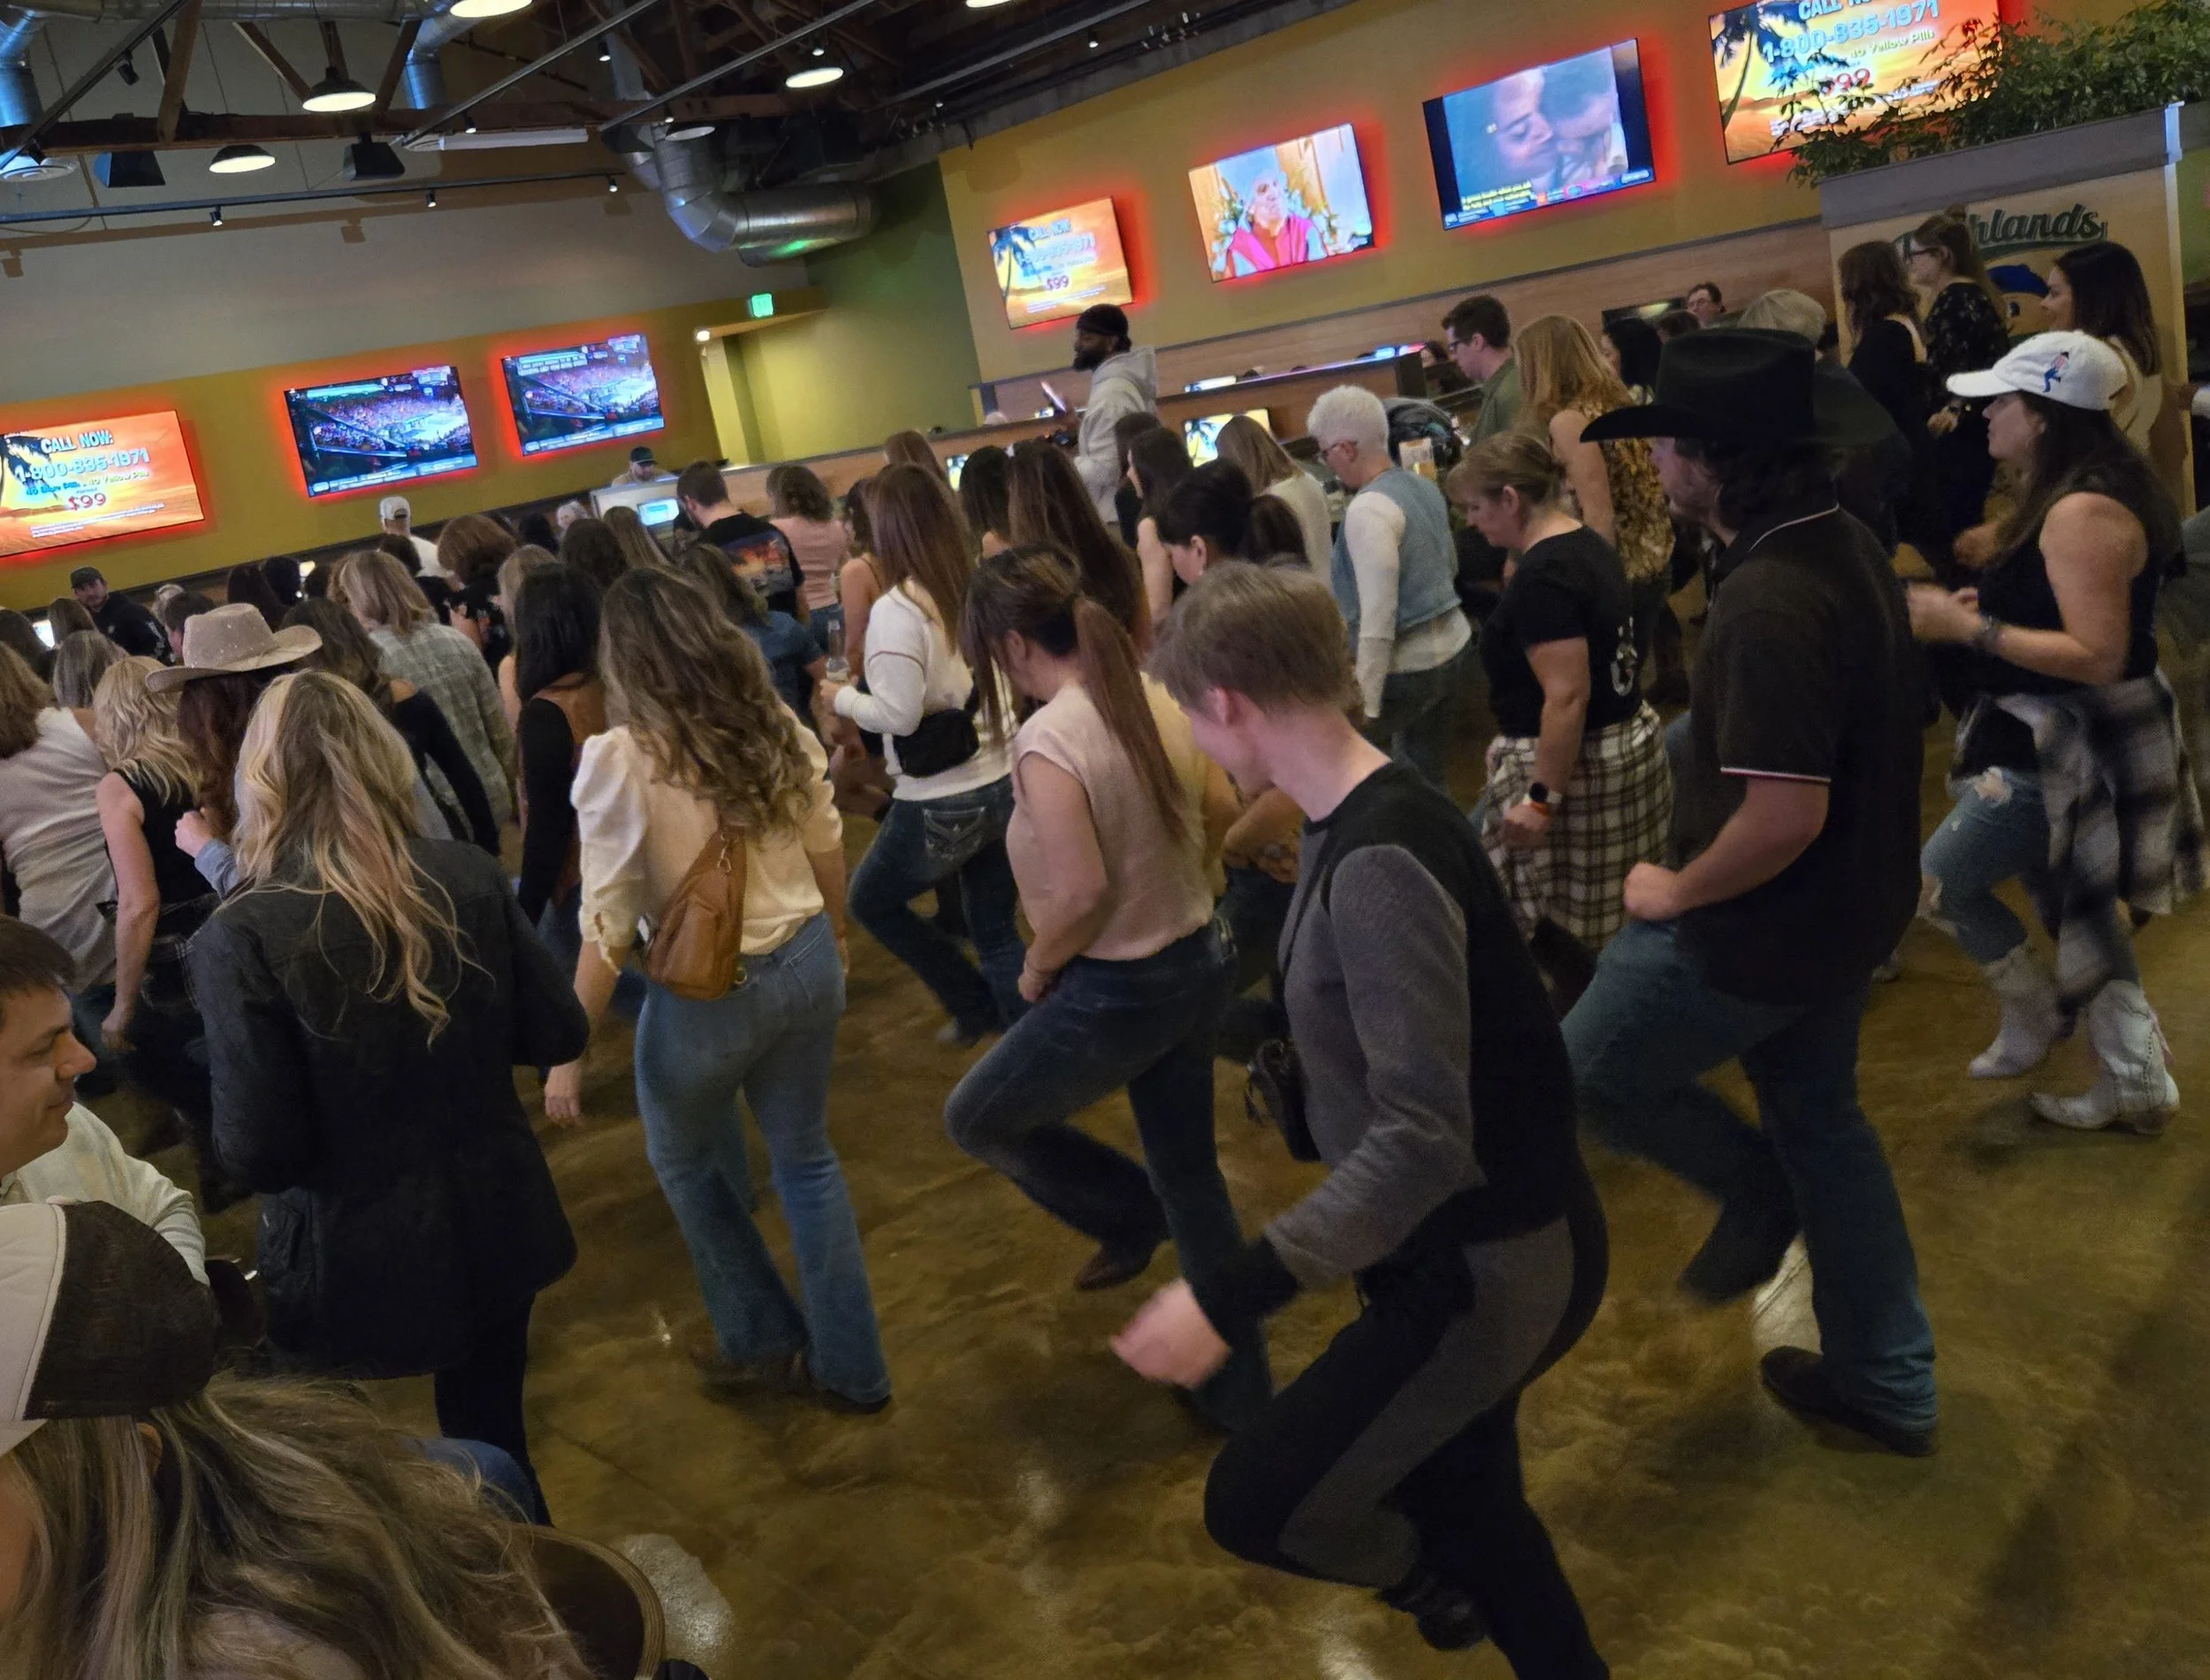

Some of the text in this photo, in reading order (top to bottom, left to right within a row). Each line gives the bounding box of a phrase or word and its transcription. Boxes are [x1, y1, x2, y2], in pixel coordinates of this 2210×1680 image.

[1798, 0, 1842, 19] CALL
[1763, 0, 1939, 63] 1-800-835-1971
[1909, 28, 1936, 44] Pills
[1821, 68, 1871, 95] 99
[41, 430, 113, 454] CALL NOW:
[68, 492, 107, 511] $99
